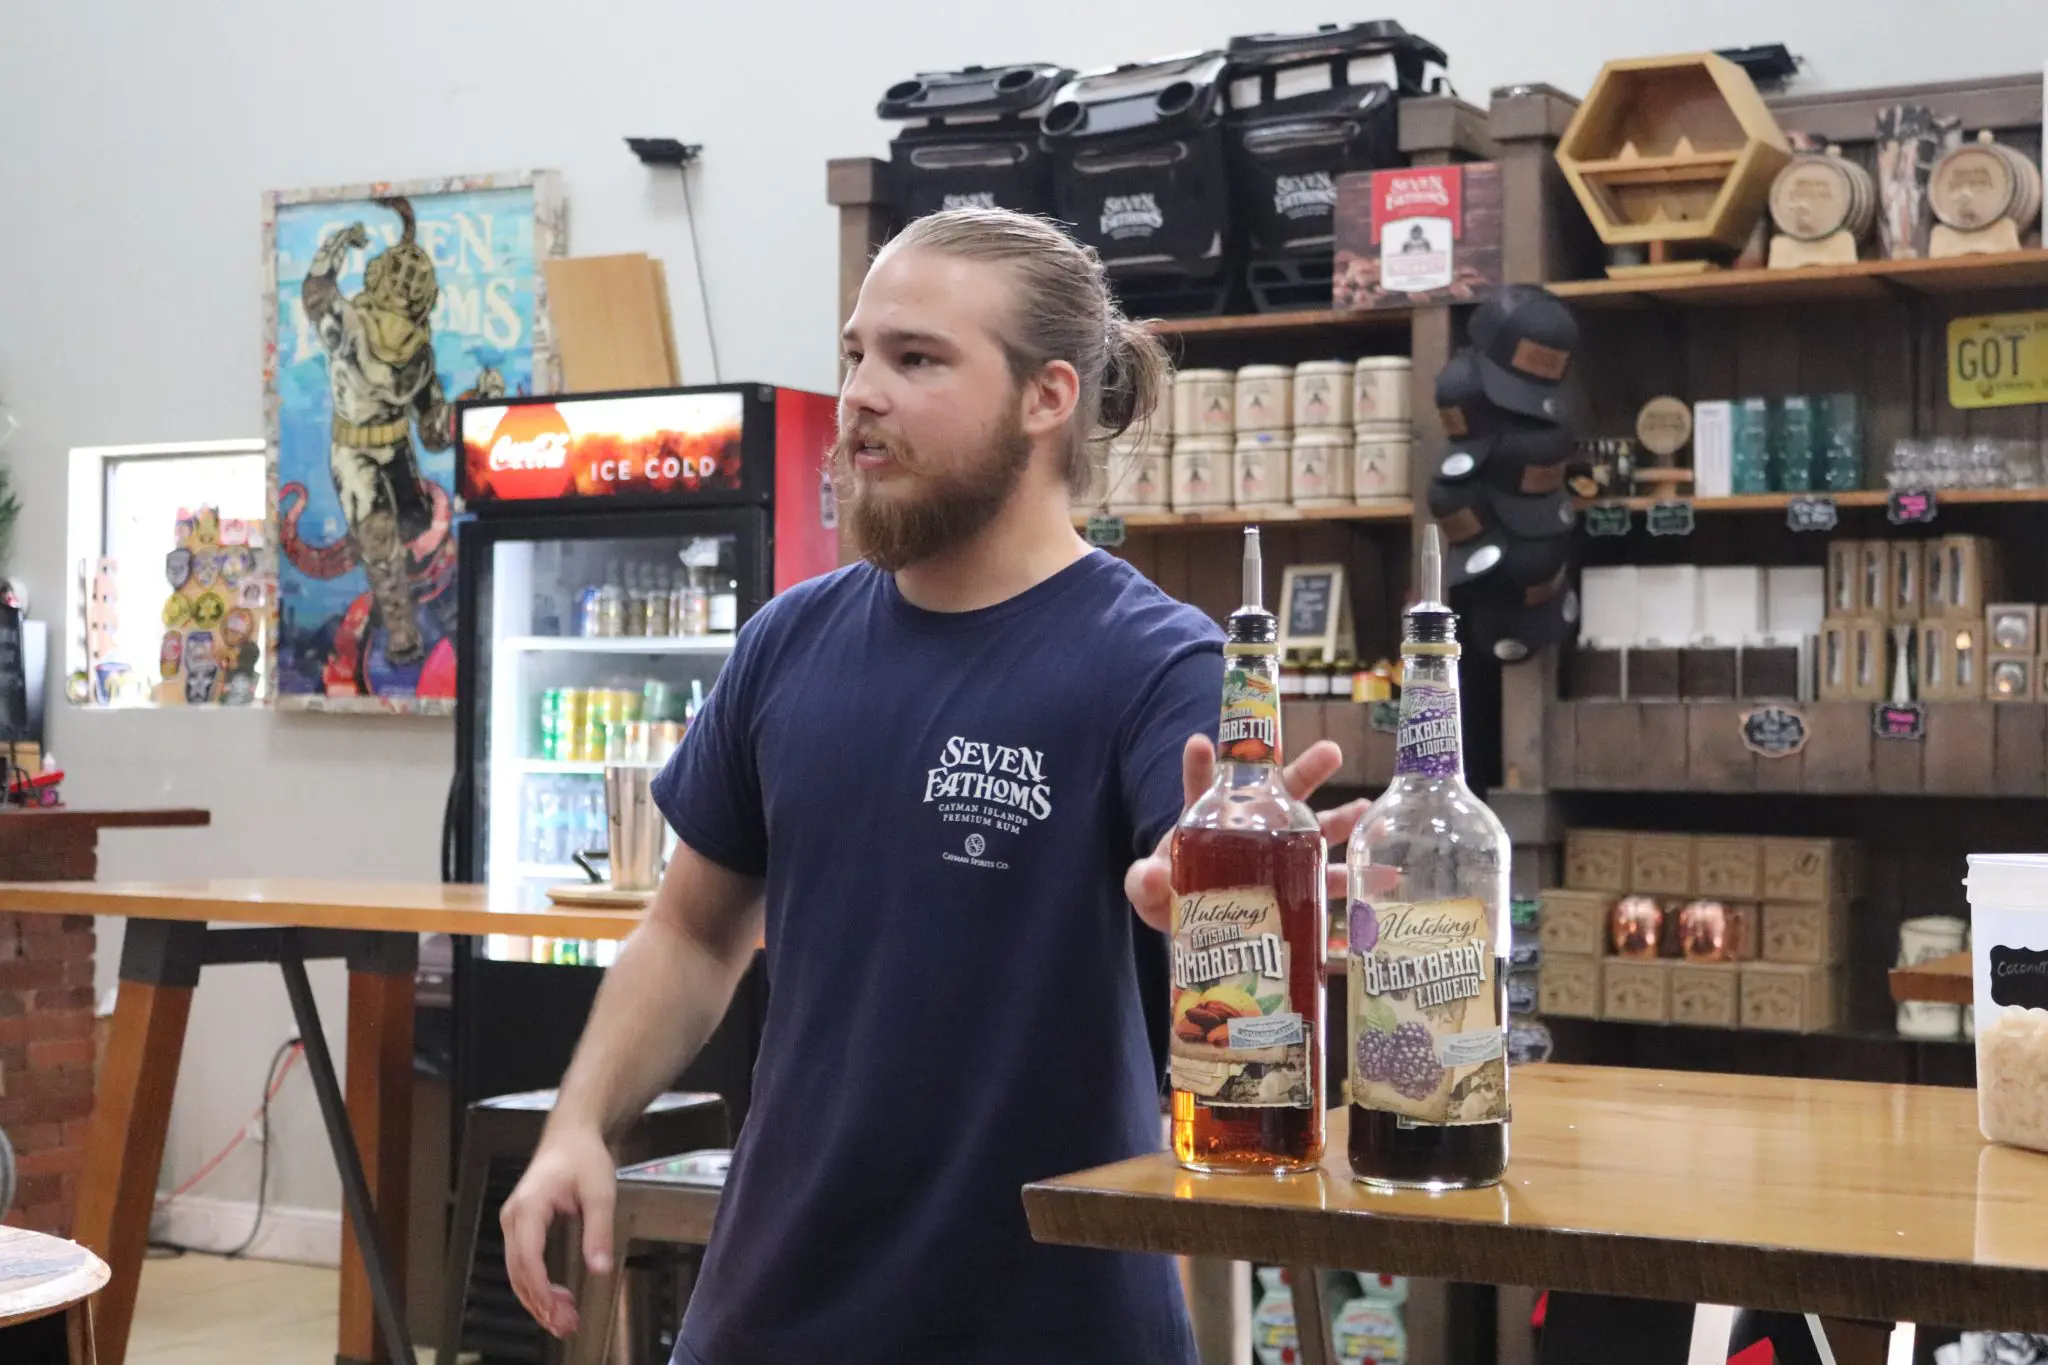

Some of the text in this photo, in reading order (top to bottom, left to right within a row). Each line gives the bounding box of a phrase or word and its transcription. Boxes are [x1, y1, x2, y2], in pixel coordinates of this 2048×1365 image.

[1958, 337, 2025, 381] GOT
[591, 456, 716, 481] ICE COLD
[940, 736, 1048, 782] SEVEN
[923, 767, 1052, 820] FATHOMS
[938, 803, 1028, 826] CAYMAN ISLANDS
[943, 813, 1020, 834] PREMIUM RUM
[1180, 895, 1275, 929] Hutchings'
[1379, 905, 1485, 941] Hutchings'
[1192, 924, 1244, 948] ARTISANAL
[1174, 932, 1285, 989] AMARETTO
[1362, 938, 1487, 996] BLACKBERRY
[1415, 976, 1481, 1009] LIQUEUR
